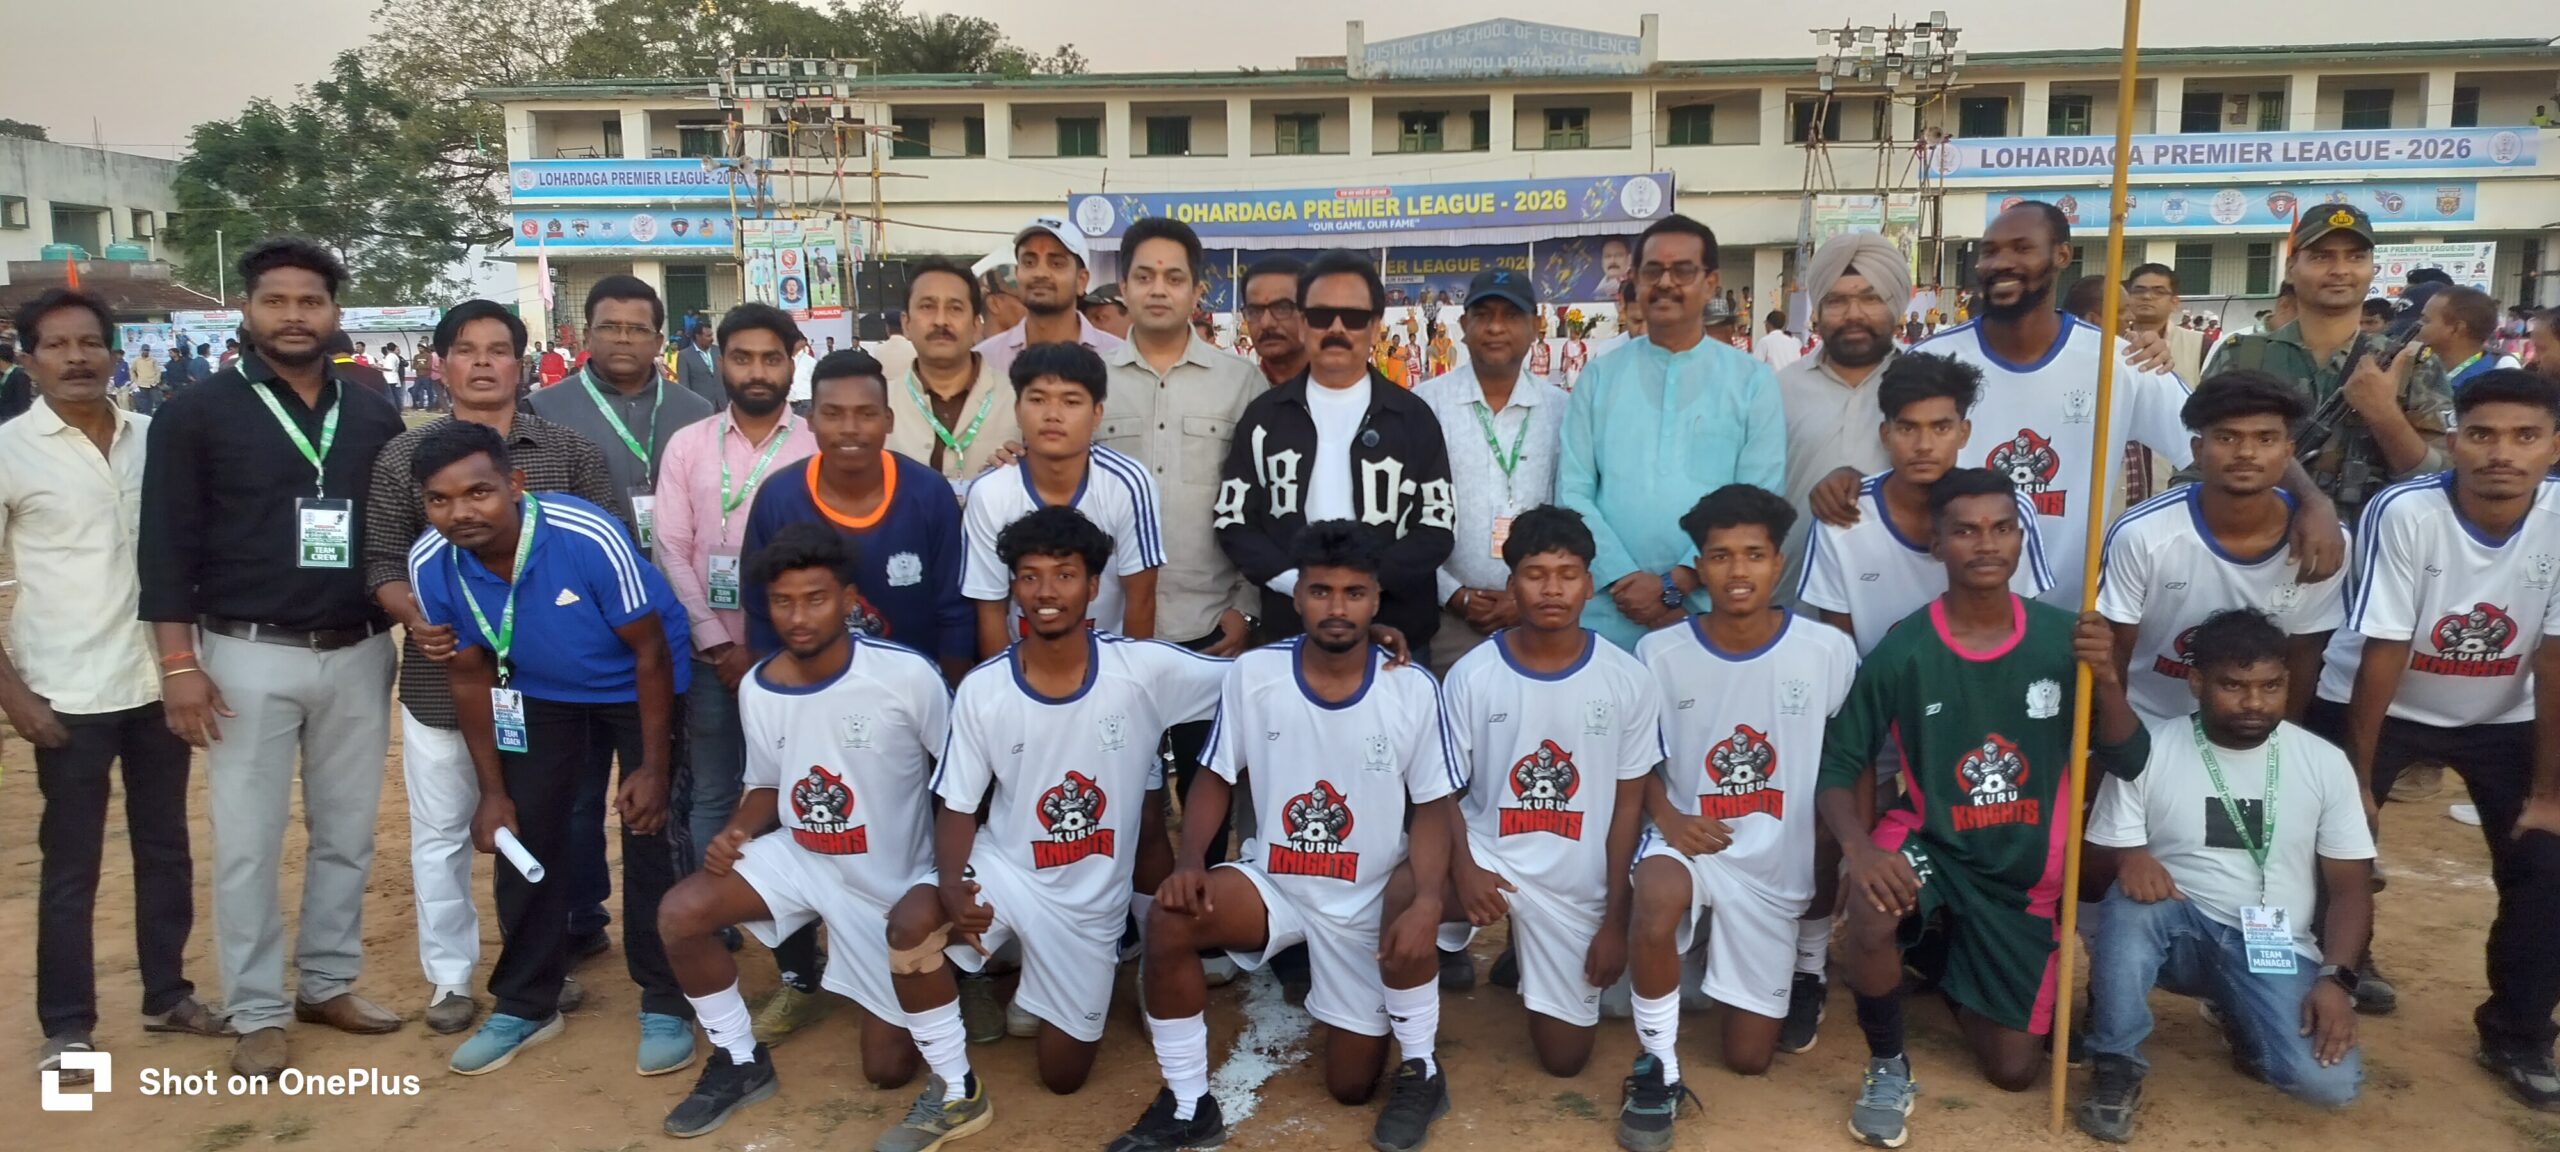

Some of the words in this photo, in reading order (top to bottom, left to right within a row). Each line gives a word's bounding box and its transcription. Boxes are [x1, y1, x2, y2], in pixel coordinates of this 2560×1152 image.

[1367, 39, 1428, 61] DISTRICT
[1433, 34, 1453, 48] CM
[1457, 23, 1511, 42] SCHOOL
[1514, 24, 1533, 39] OF
[1540, 28, 1637, 52] EXCELLENCE
[1400, 57, 1443, 70] NADIA
[1498, 54, 1590, 69] LOHARDAG
[2153, 141, 2272, 166] PREMIER
[2282, 139, 2390, 162] LEAGUE
[2407, 137, 2471, 160] 2026
[539, 171, 608, 186] LOHARDAGA
[612, 171, 661, 186] PREMIER
[665, 170, 710, 185] LEAGUE
[1165, 202, 1297, 224] LOHARDAGA
[1304, 197, 1400, 220] PREMIER
[1407, 193, 1495, 216] LEAGUE
[1514, 190, 1567, 211] 2026
[1631, 207, 1650, 215] LPL
[1336, 220, 1366, 231] GAME,
[1367, 219, 1388, 229] OUR
[1413, 258, 1480, 274] LEAGUE
[311, 553, 338, 561] CREW
[314, 546, 336, 554] TEAM
[2442, 651, 2499, 662] KURU
[502, 737, 522, 746] COACH
[504, 729, 518, 738] TEAM
[1723, 780, 1765, 796] KURU
[1523, 799, 1566, 811] KURU
[1974, 790, 2018, 806] KURU
[1951, 798, 2040, 832] KNIGHTS
[804, 822, 846, 834] KURU
[1499, 809, 1583, 839] KNIGHTS
[1053, 825, 1096, 843] KURU
[1032, 829, 1114, 868] KNIGHTS
[1292, 840, 1338, 854] KURU
[1268, 844, 1358, 882] KNIGHTS
[2260, 950, 2283, 959] TEAM
[2252, 959, 2293, 968] MANAGER
